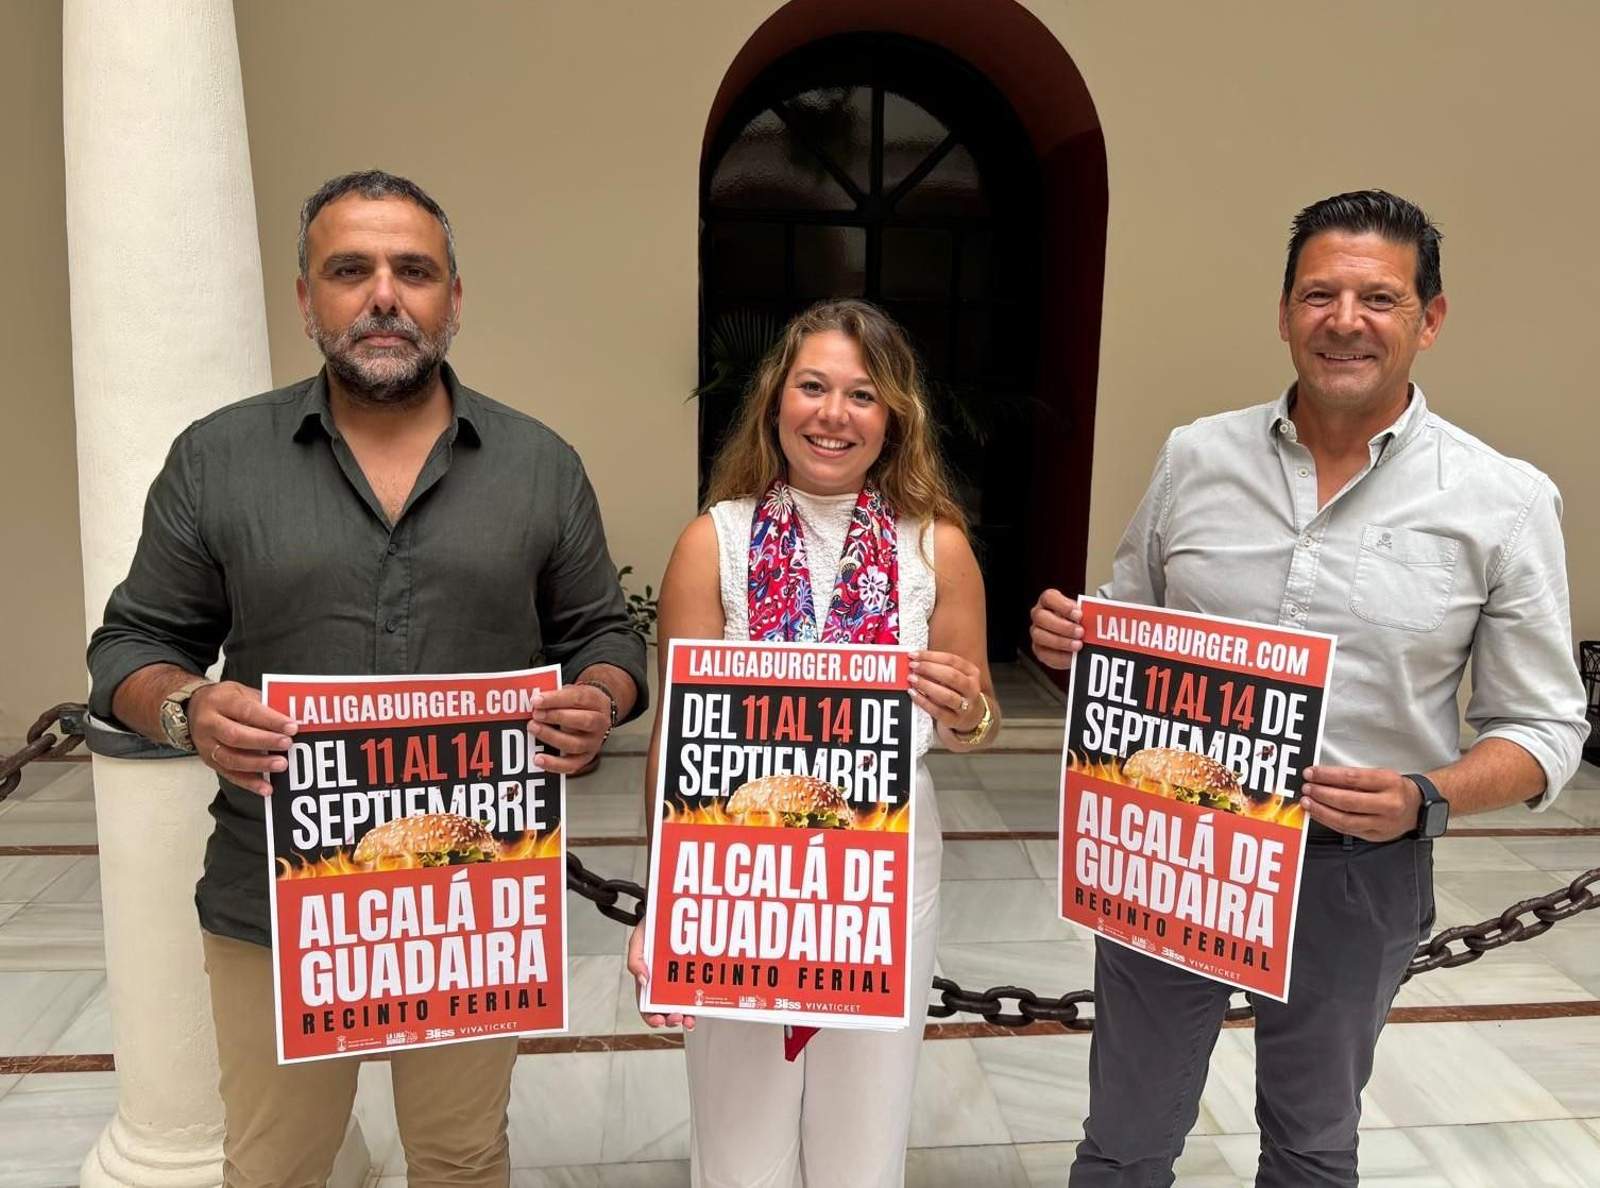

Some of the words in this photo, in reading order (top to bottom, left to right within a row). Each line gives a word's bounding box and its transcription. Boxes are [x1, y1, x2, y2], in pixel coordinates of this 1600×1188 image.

[689, 649, 897, 683] LALIGABURGER.COM
[1096, 615, 1310, 677] LALIGABURGER.COM
[289, 687, 542, 725] LALIGABURGER.COM
[681, 693, 736, 739] DEL
[742, 695, 771, 740] 11
[774, 696, 813, 742] AL
[817, 697, 853, 743] 14
[859, 698, 899, 745] DE
[1087, 653, 1137, 707] DEL
[1144, 665, 1172, 713] 11
[1172, 671, 1211, 723] AL
[1219, 681, 1255, 731] 14
[1260, 688, 1307, 741] DE
[288, 739, 358, 791] DEL
[360, 736, 395, 784] 11
[403, 735, 447, 783] AL
[452, 731, 494, 779] 14
[501, 729, 545, 775] DE
[679, 743, 899, 803] SEPTIEMBRE
[1082, 702, 1300, 798] SEPTIEMBRE
[291, 778, 547, 850] SEPTIEMBRE
[1076, 790, 1214, 875] ALCALÁ
[1229, 832, 1284, 893] DE
[673, 833, 828, 899] ALCALÁ
[843, 848, 895, 903] DE
[1075, 837, 1274, 949] GUADAIRA
[299, 868, 476, 949] ALCALÁ
[492, 875, 547, 928] DE
[669, 897, 892, 965] GUADAIRA
[1075, 887, 1167, 937] RECINTO
[1183, 928, 1270, 972] FERIAL
[300, 929, 548, 1007] GUADAIRA
[668, 961, 778, 988] RECINTO
[798, 967, 890, 993] FERIAL
[1189, 958, 1241, 980] VIVATICKET
[302, 1000, 428, 1035] RECINTO
[450, 988, 547, 1016] FERIAL
[460, 1022, 518, 1034] VIVATICKET
[805, 1002, 861, 1013] VIVATICKET
